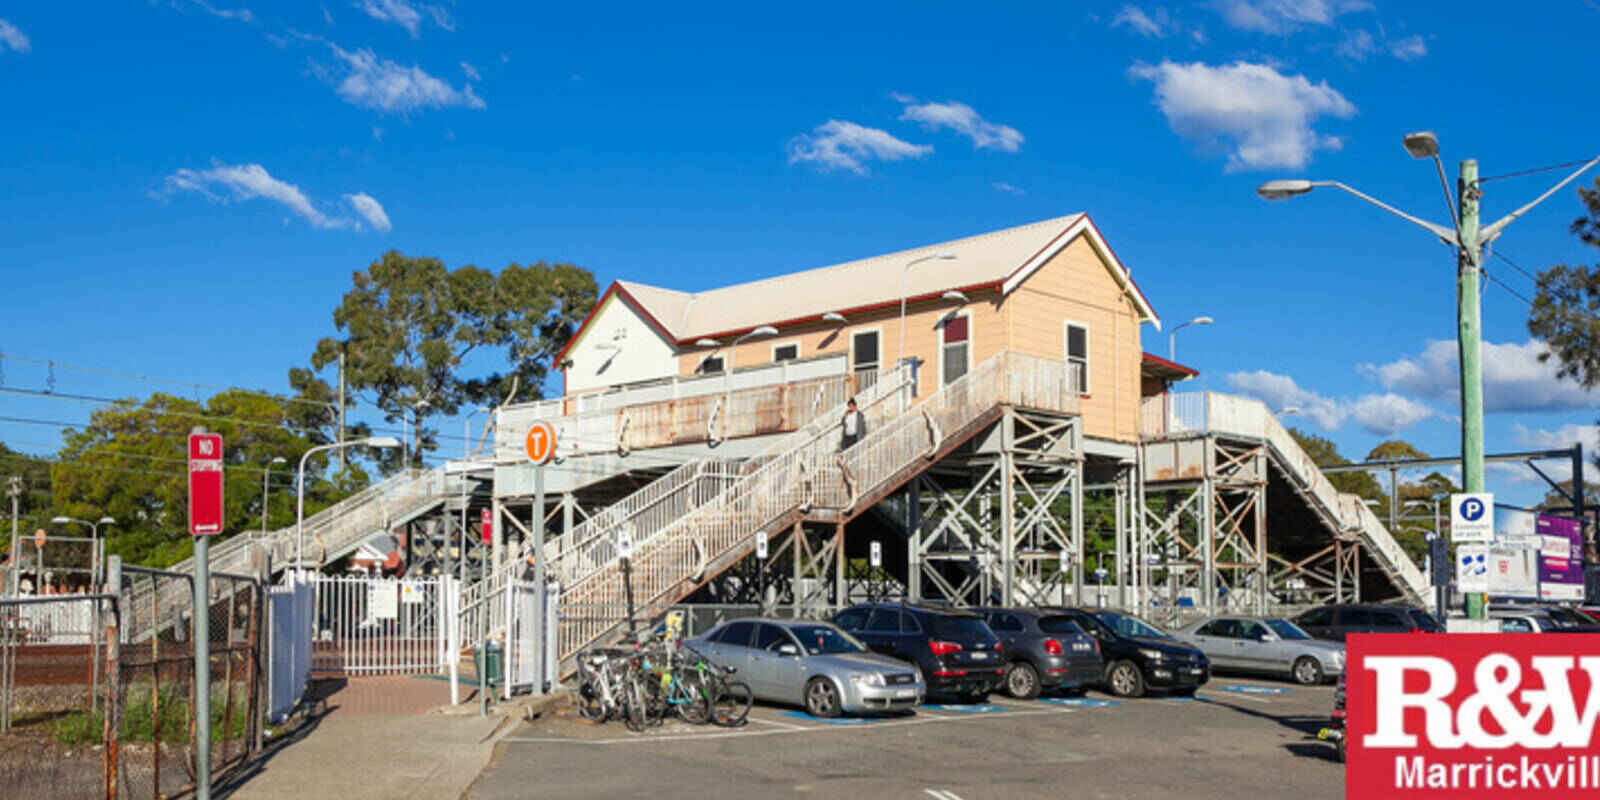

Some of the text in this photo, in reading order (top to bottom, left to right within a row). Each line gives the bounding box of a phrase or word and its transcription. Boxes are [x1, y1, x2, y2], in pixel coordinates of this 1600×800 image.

[199, 439, 214, 456] NO
[531, 432, 543, 457] T
[1466, 501, 1480, 519] P
